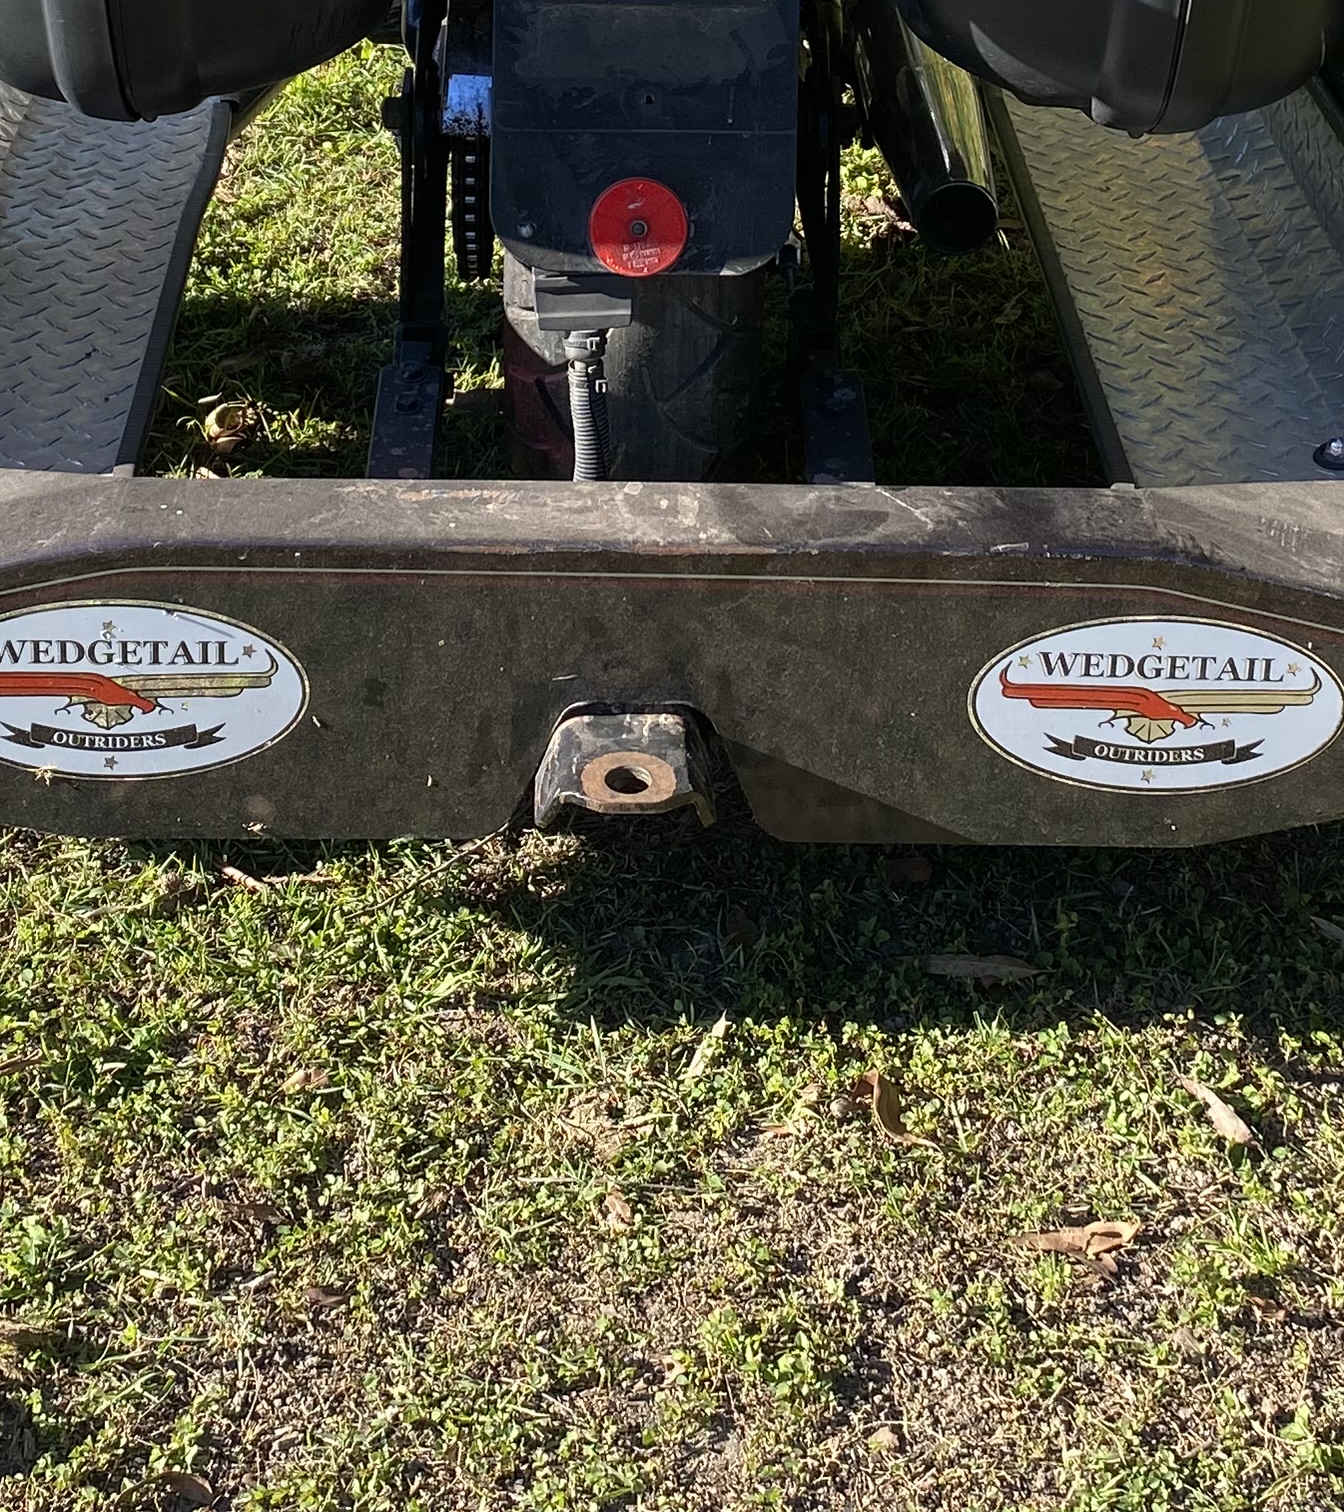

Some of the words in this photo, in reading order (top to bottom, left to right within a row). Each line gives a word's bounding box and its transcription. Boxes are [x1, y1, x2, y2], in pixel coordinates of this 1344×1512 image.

[1038, 651, 1283, 683] WEDGETAIL
[52, 729, 167, 749] OUTRIDERS
[1093, 743, 1205, 763] OUTRIDERS
